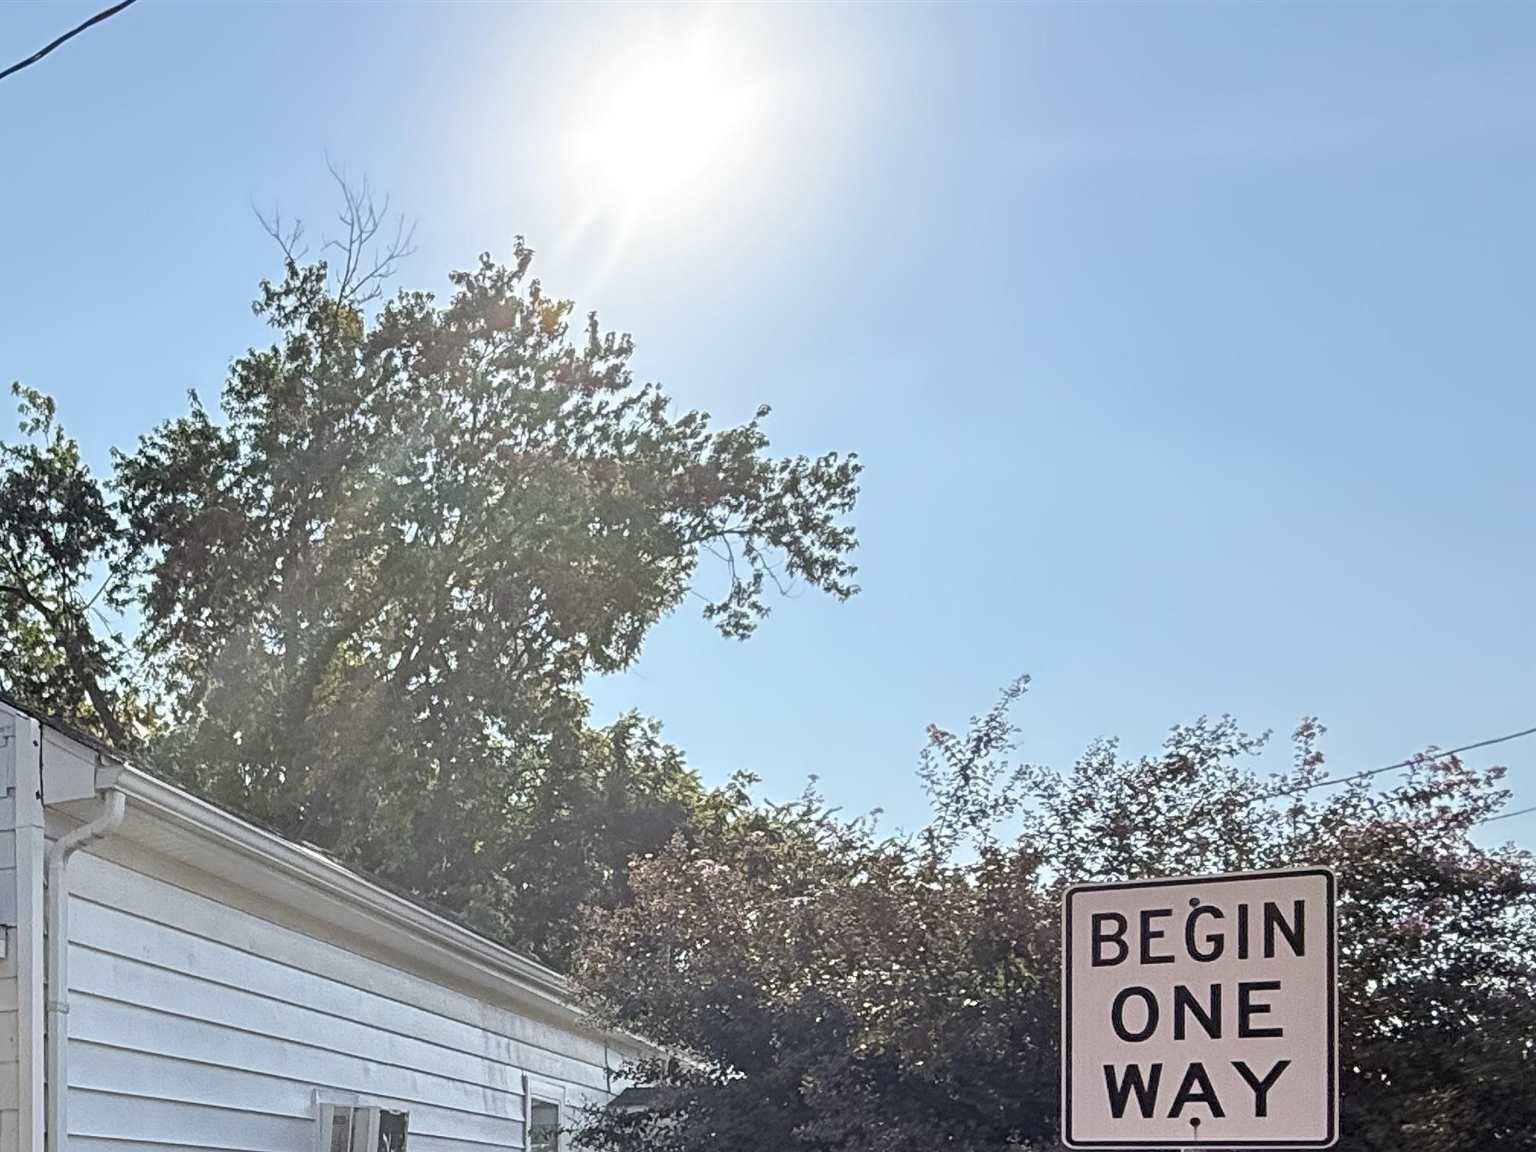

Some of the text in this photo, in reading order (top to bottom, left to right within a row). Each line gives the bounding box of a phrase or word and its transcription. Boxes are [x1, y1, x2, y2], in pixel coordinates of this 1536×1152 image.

[1091, 900, 1305, 967] BEGIN
[1111, 980, 1283, 1043] ONE
[1103, 1060, 1292, 1119] WAY
